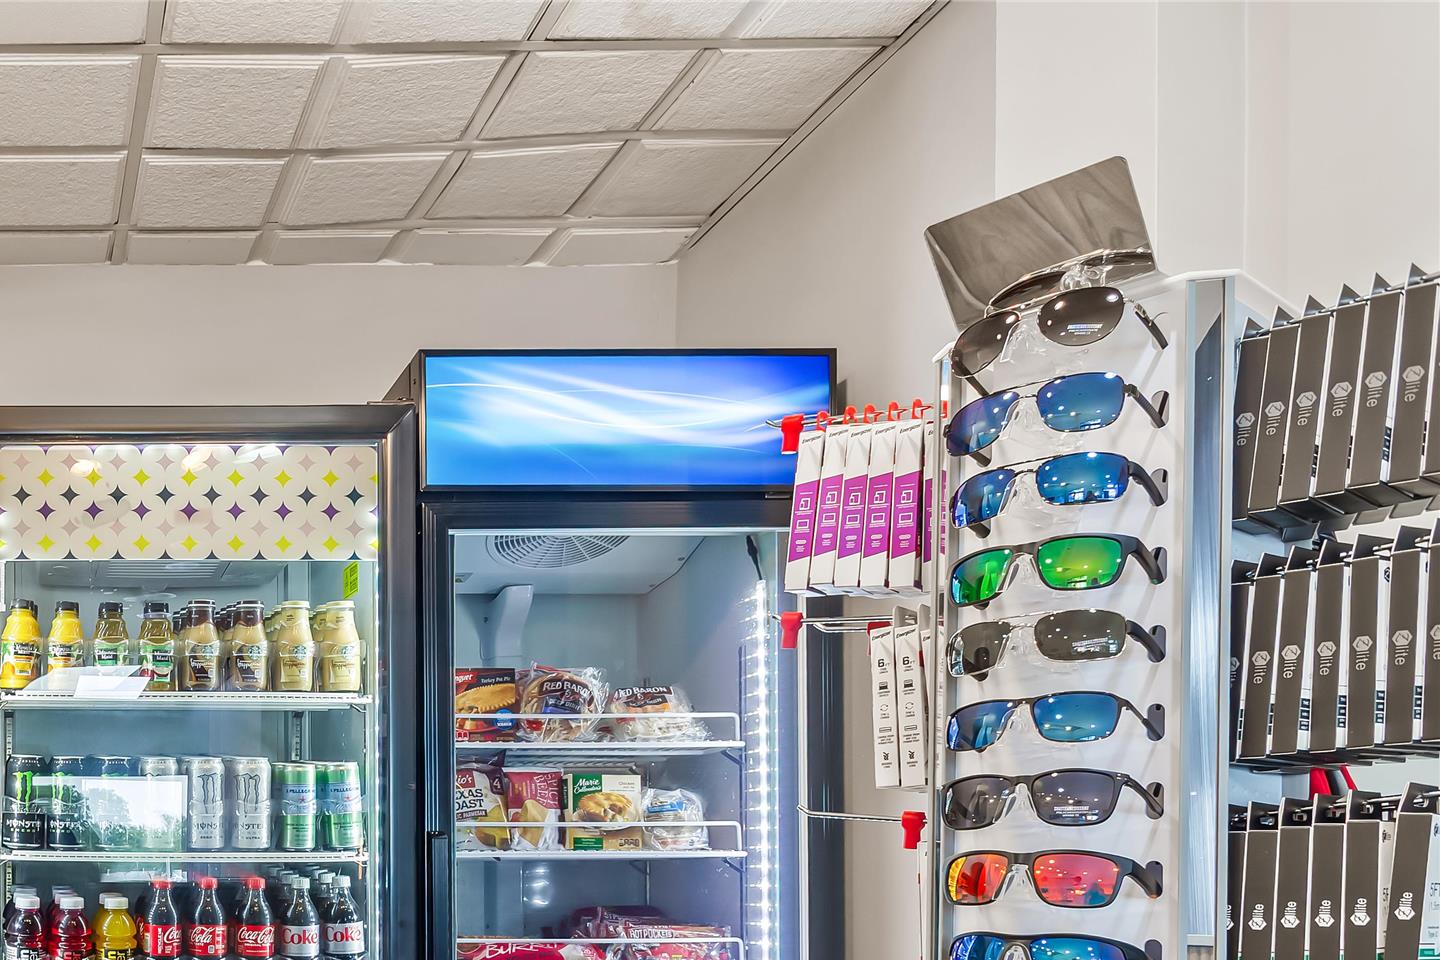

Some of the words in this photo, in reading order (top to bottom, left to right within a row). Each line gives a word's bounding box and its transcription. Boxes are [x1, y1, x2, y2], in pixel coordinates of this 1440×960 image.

[543, 682, 563, 691] RED
[576, 778, 600, 789] Marie
[282, 928, 318, 944] Coke
[324, 926, 361, 942] Coke
